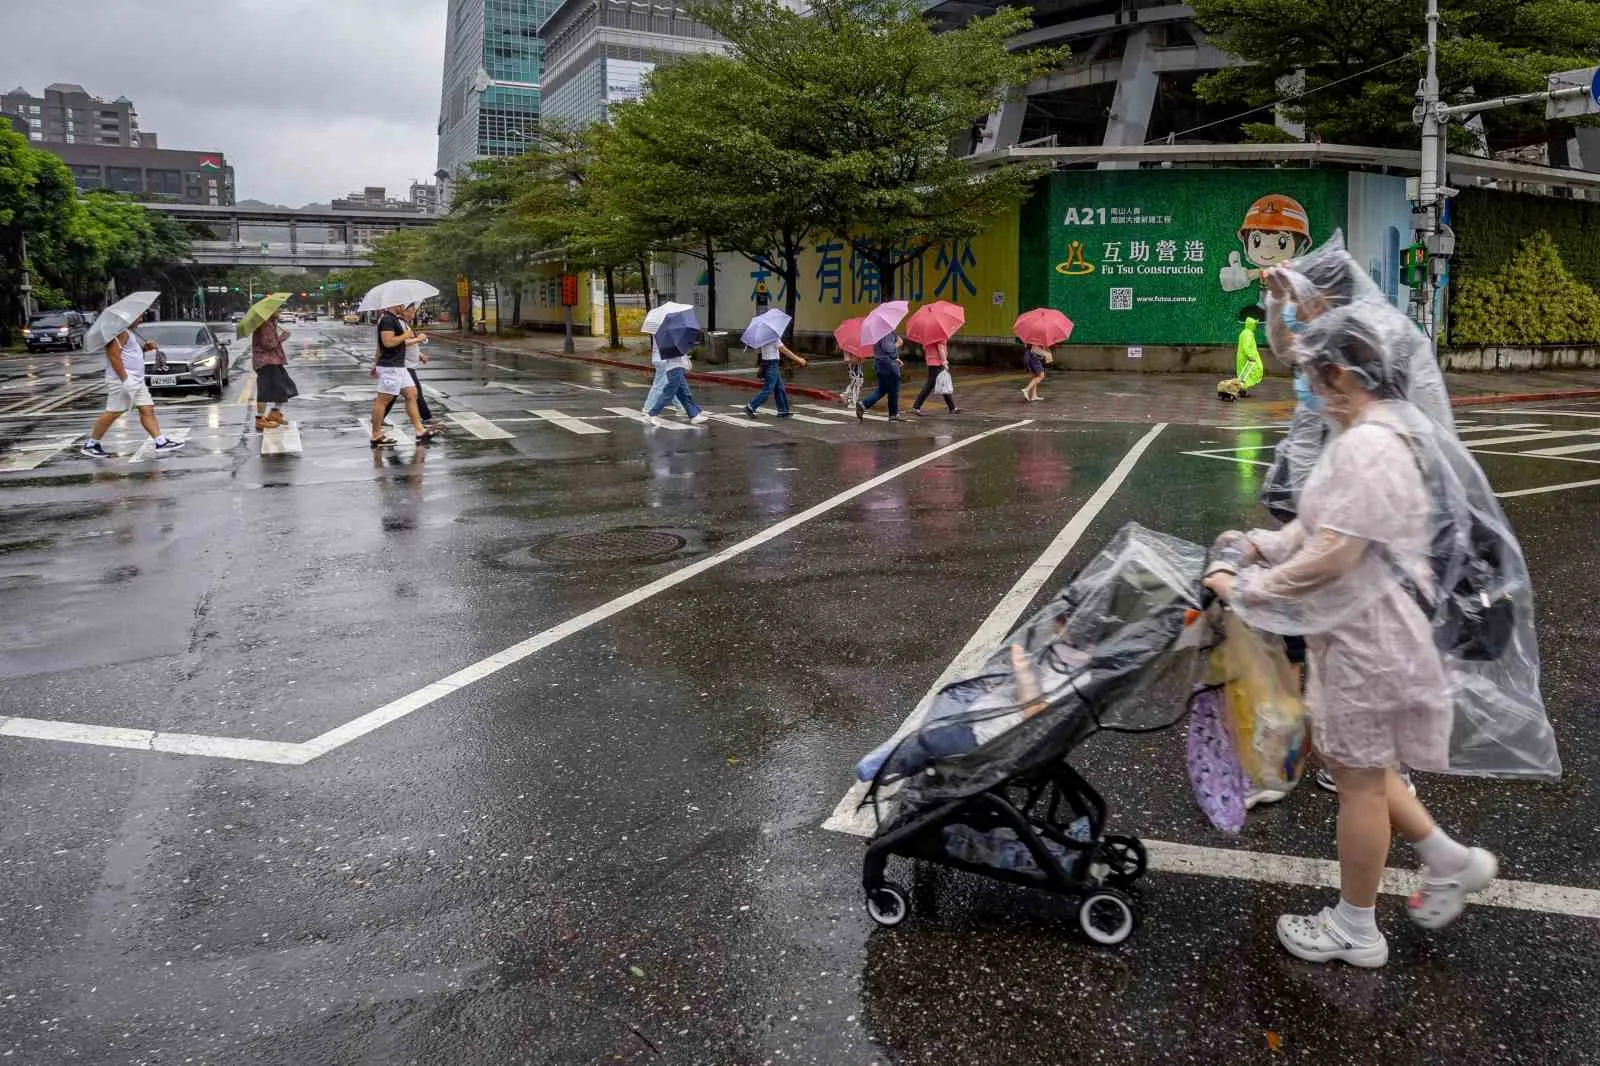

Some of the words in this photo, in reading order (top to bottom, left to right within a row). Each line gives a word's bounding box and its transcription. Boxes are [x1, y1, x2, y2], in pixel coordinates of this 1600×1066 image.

[1063, 207, 1106, 225] A21
[1102, 239, 1205, 262] 互助營造
[1101, 264, 1114, 274] Fu
[1117, 264, 1134, 274] Tsu
[1136, 264, 1205, 274] Construction
